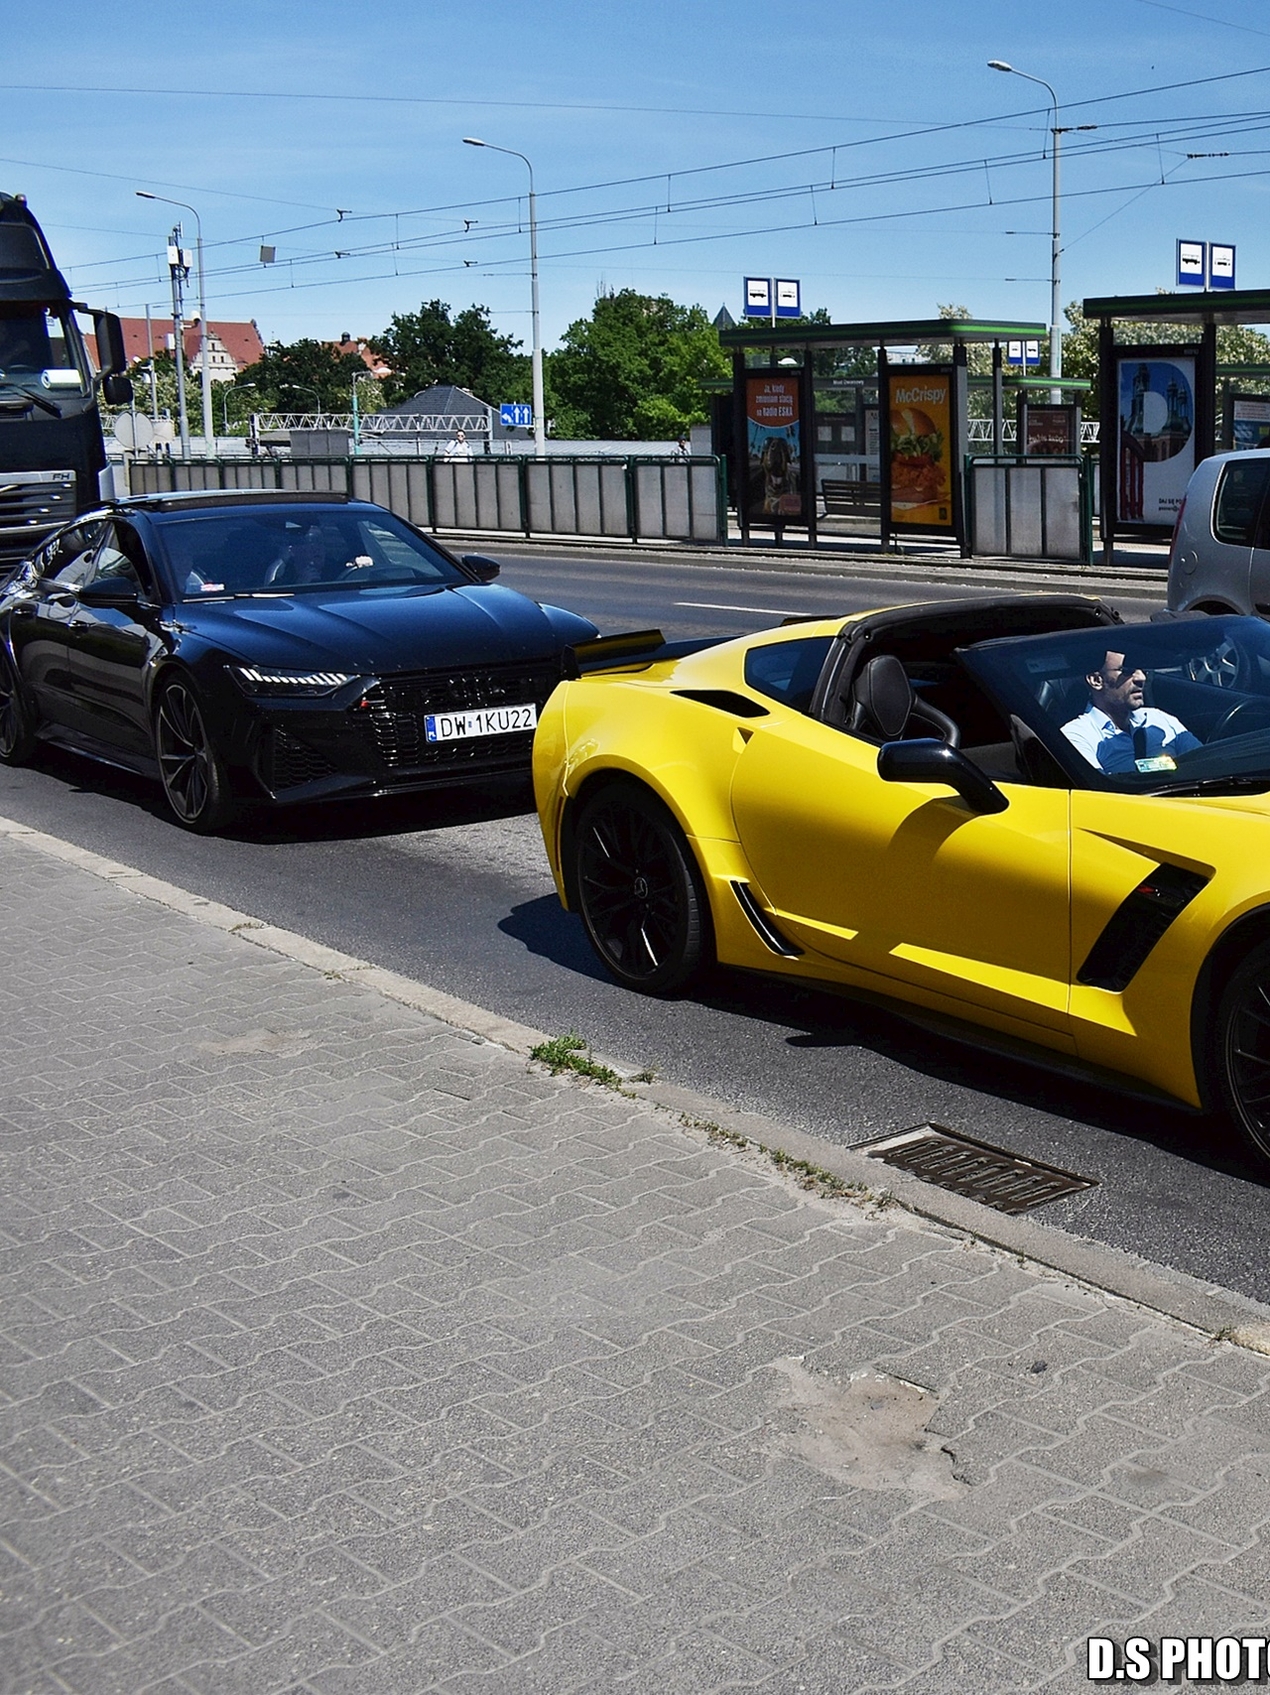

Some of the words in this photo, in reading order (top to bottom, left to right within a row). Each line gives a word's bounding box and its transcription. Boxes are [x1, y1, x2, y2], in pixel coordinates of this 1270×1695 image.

[895, 386, 946, 404] McCrispy
[440, 716, 466, 737] DW
[475, 709, 532, 733] 1KU22
